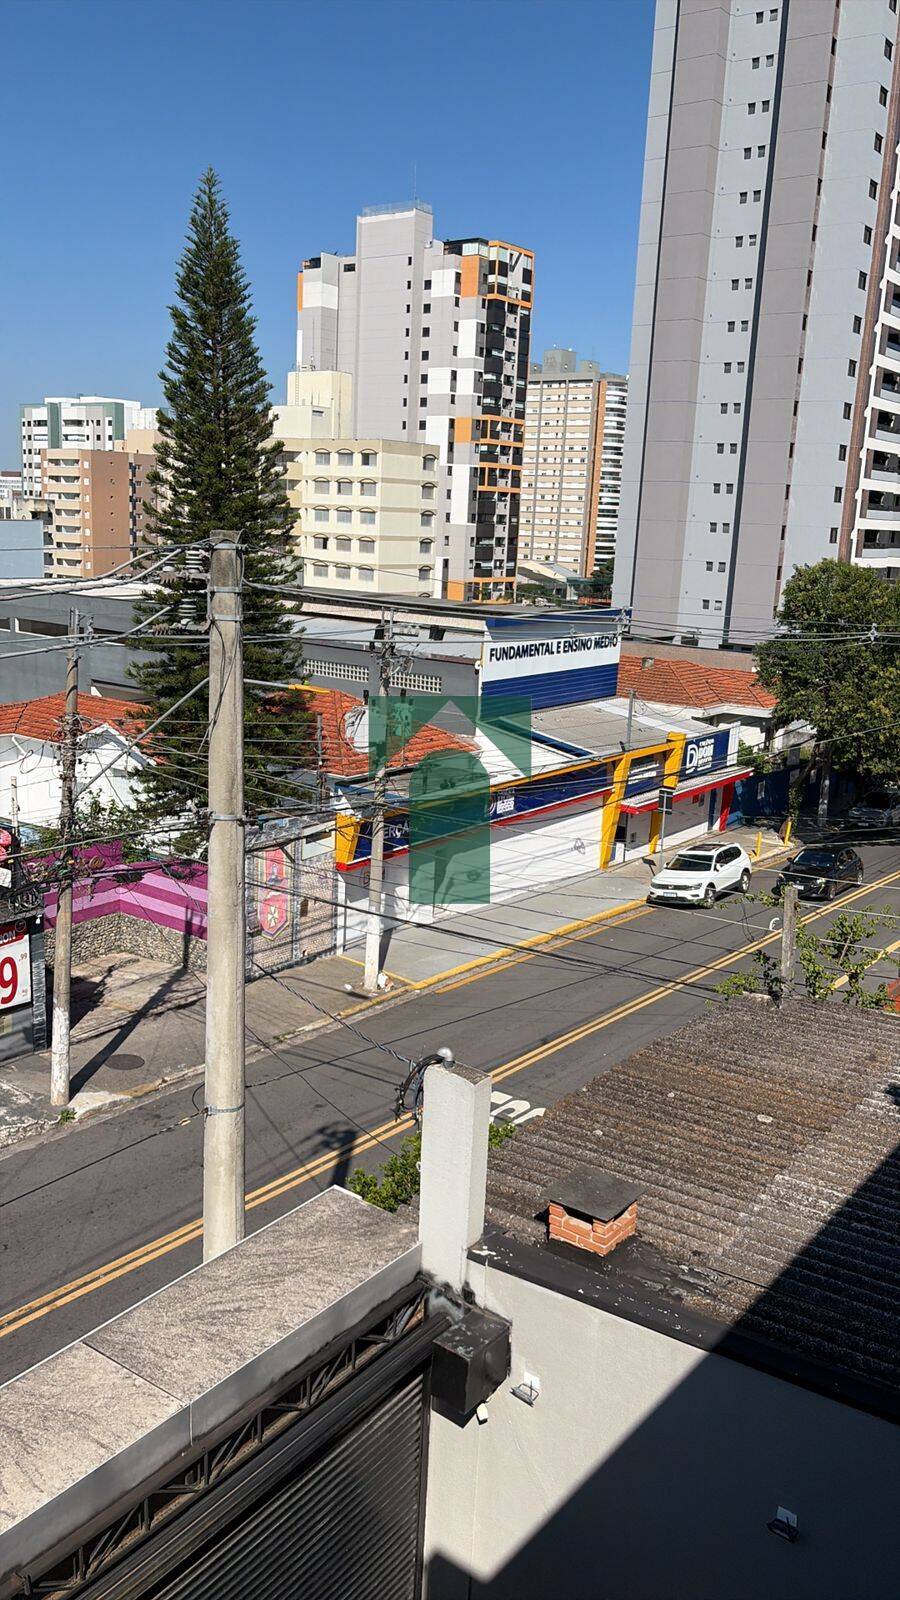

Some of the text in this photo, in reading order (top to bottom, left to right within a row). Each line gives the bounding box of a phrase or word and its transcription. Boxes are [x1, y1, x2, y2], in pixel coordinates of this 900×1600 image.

[489, 642, 554, 662] FUNDAMENTAL
[556, 641, 562, 654] E
[563, 637, 592, 653] ENSINO
[0, 956, 18, 1005] 9
